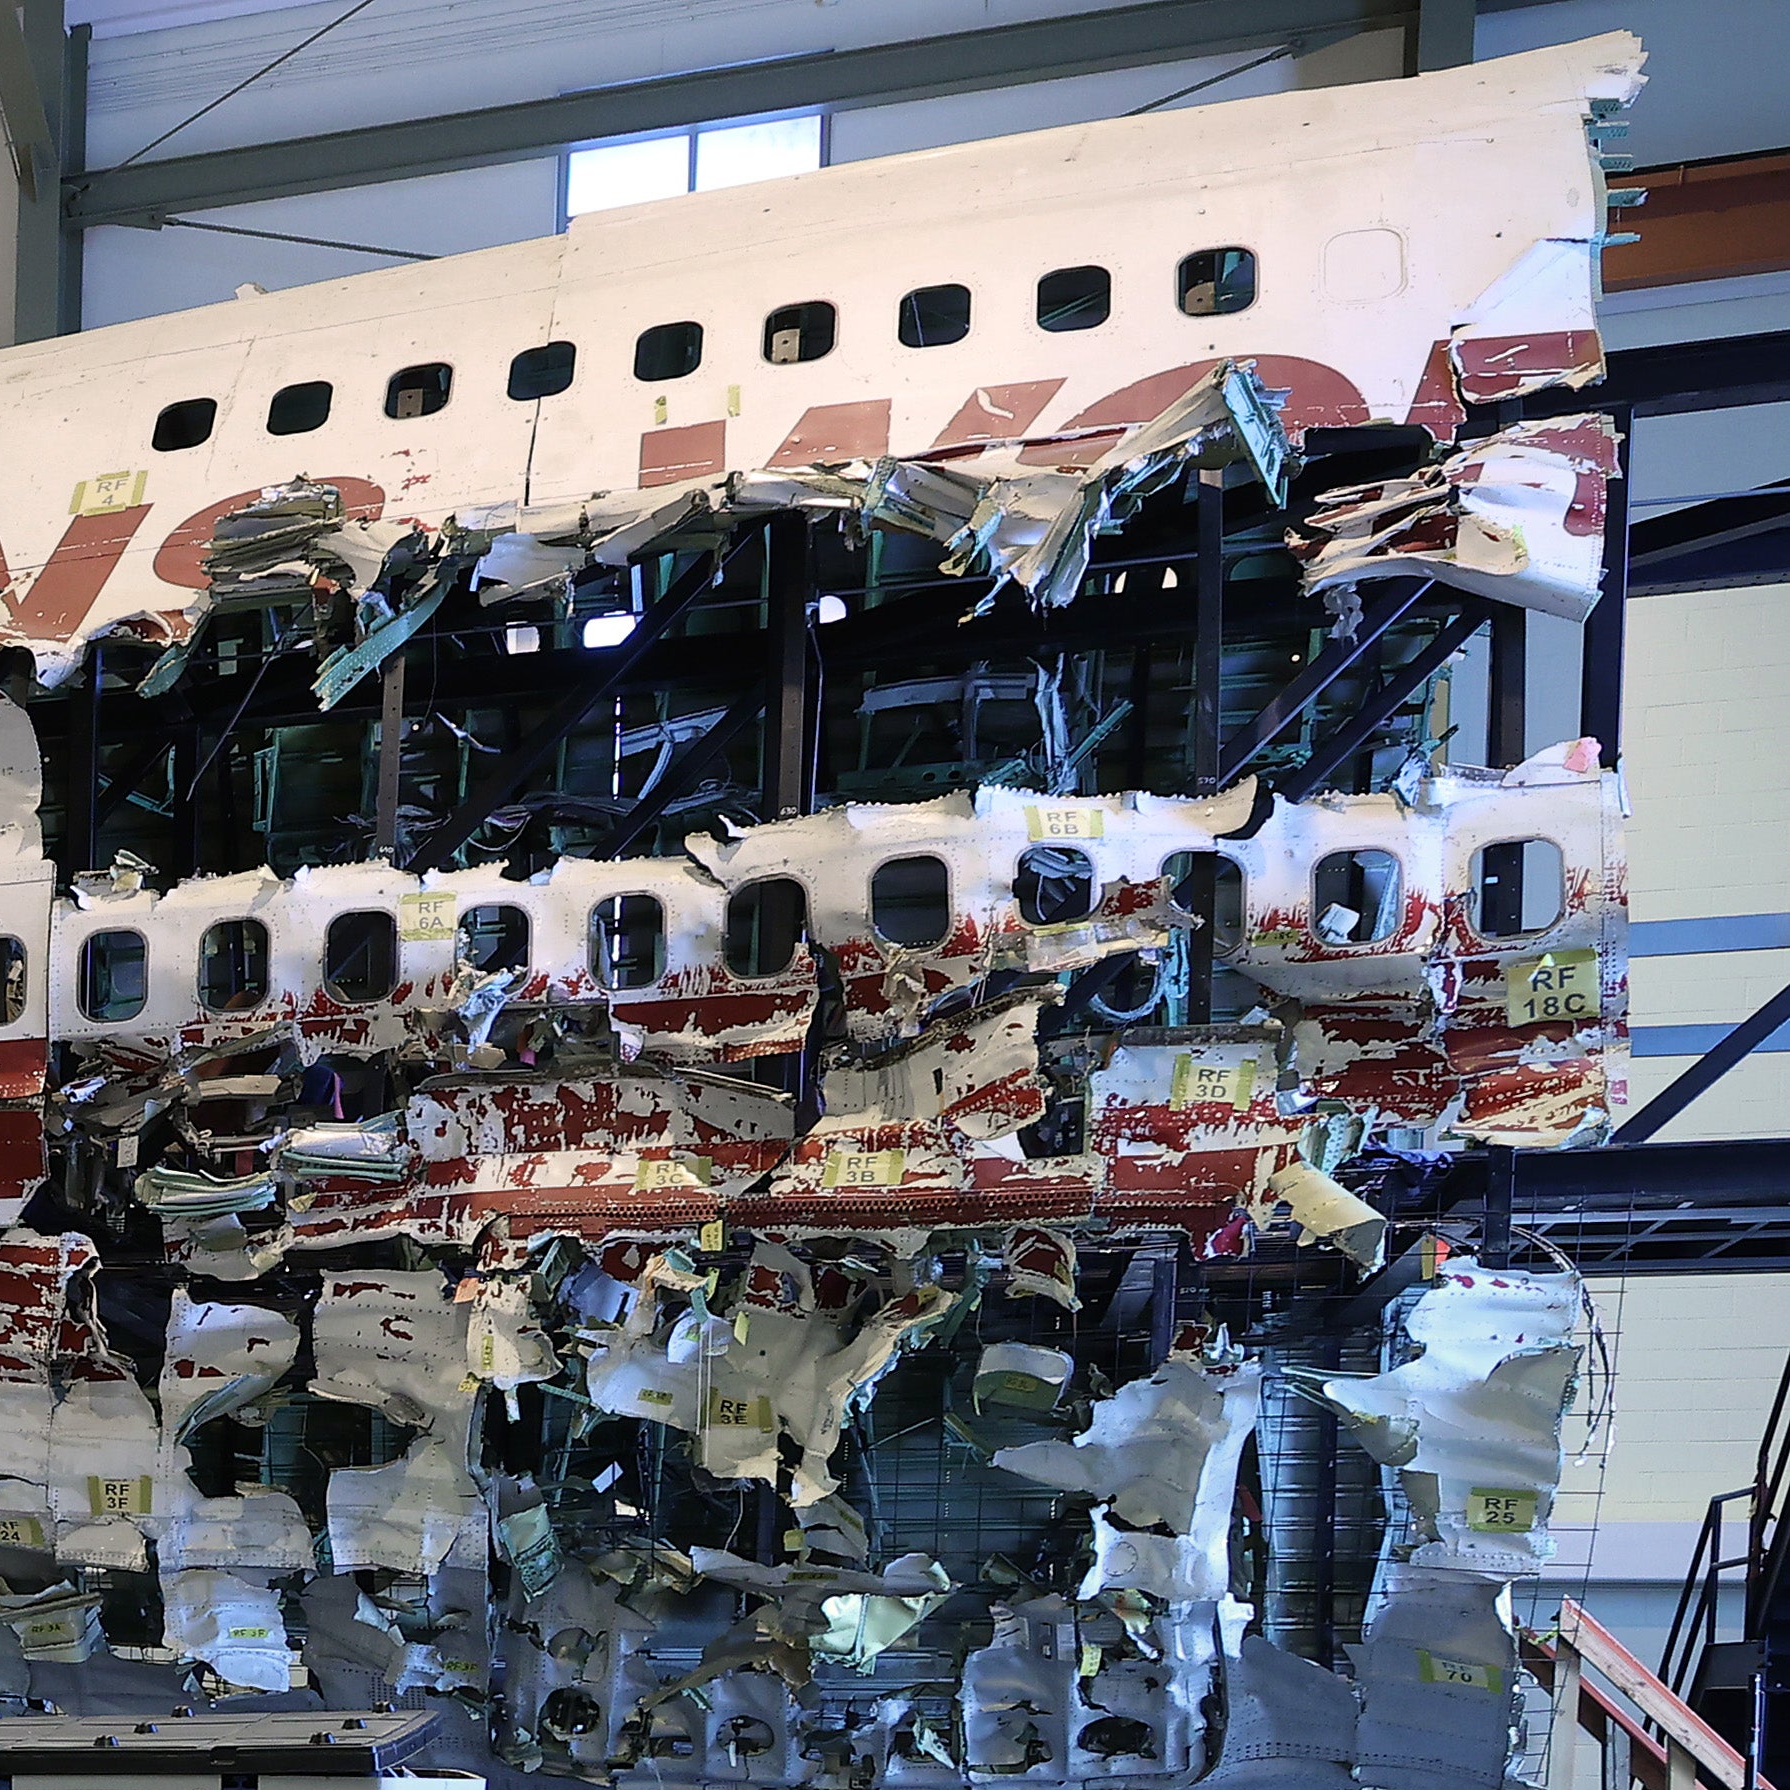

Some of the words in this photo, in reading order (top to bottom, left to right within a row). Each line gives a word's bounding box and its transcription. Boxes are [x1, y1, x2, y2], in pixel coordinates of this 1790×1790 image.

[97, 480, 128, 493] RF
[102, 495, 113, 505] 4
[1047, 811, 1077, 822] RF
[1050, 823, 1078, 835] 6B
[418, 901, 442, 913] RF
[419, 917, 444, 929] 6A
[1531, 966, 1576, 991] RF
[1523, 993, 1585, 1018] 18C
[1197, 1069, 1231, 1083] RF
[1196, 1084, 1226, 1099] 3D
[656, 1161, 686, 1174] RF
[847, 1156, 879, 1169] RF
[656, 1174, 684, 1185] 3C
[846, 1170, 875, 1183] 3B
[720, 1399, 747, 1414] RF
[721, 1415, 747, 1425] 3E
[105, 1484, 130, 1495] RF
[107, 1497, 129, 1509] 3F
[1484, 1498, 1519, 1510] RF
[1486, 1511, 1516, 1524] 25
[0, 1530, 21, 1541] 24
[232, 1630, 247, 1638] RF
[250, 1629, 265, 1638] 3F
[1446, 1670, 1472, 1683] 70
